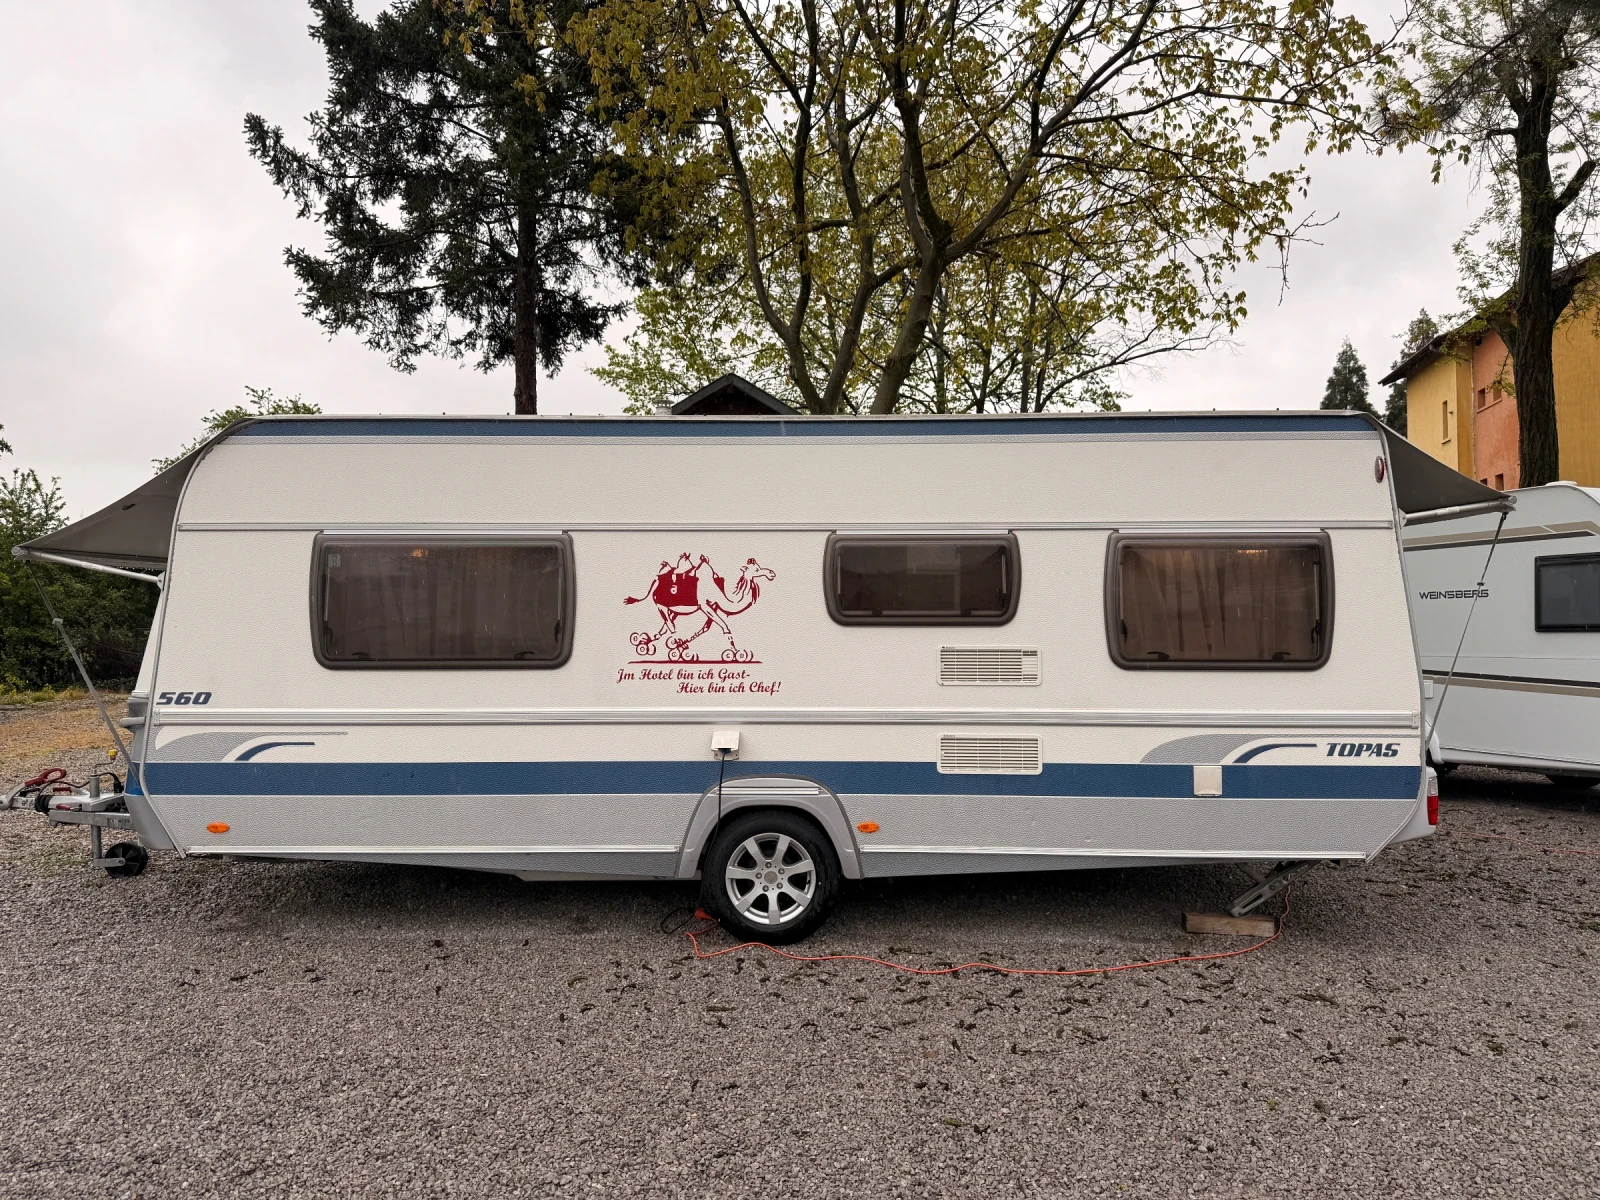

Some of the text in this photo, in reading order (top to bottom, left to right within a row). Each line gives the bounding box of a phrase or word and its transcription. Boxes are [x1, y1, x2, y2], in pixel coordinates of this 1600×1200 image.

[1419, 589, 1489, 600] WEINSBERG
[639, 669, 673, 680] Hotel
[677, 669, 695, 680] bin
[698, 669, 714, 680] ich
[717, 668, 751, 682] Gast-
[676, 681, 782, 696] Hier bin ich Chef!
[156, 691, 212, 705] 560
[1326, 742, 1401, 758] TOPAS
